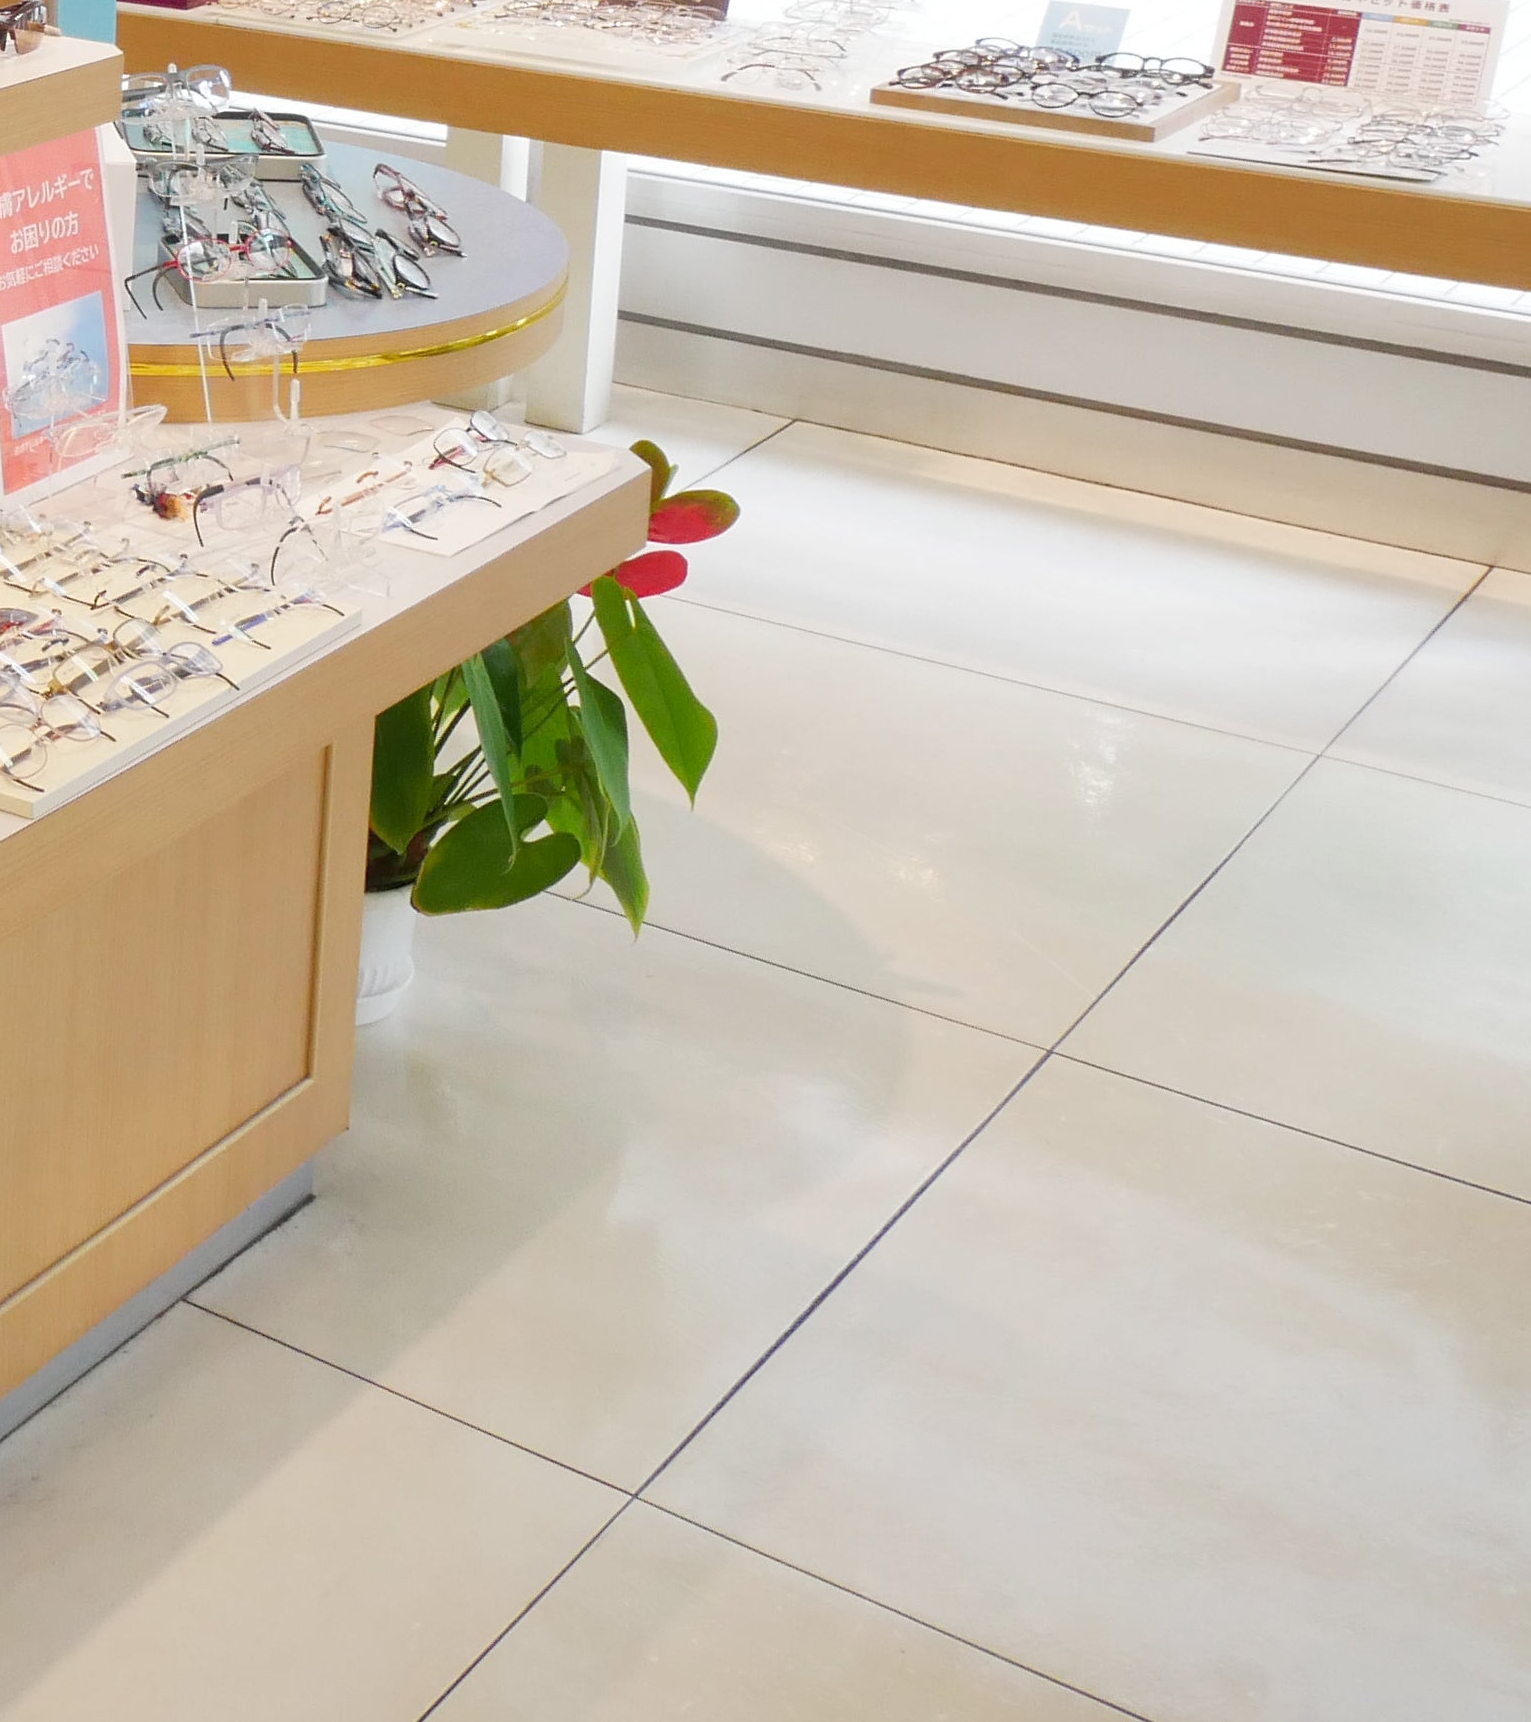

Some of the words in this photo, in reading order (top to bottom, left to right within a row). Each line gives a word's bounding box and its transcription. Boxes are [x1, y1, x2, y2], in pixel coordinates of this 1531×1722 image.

[10, 211, 79, 255] お困りの方
